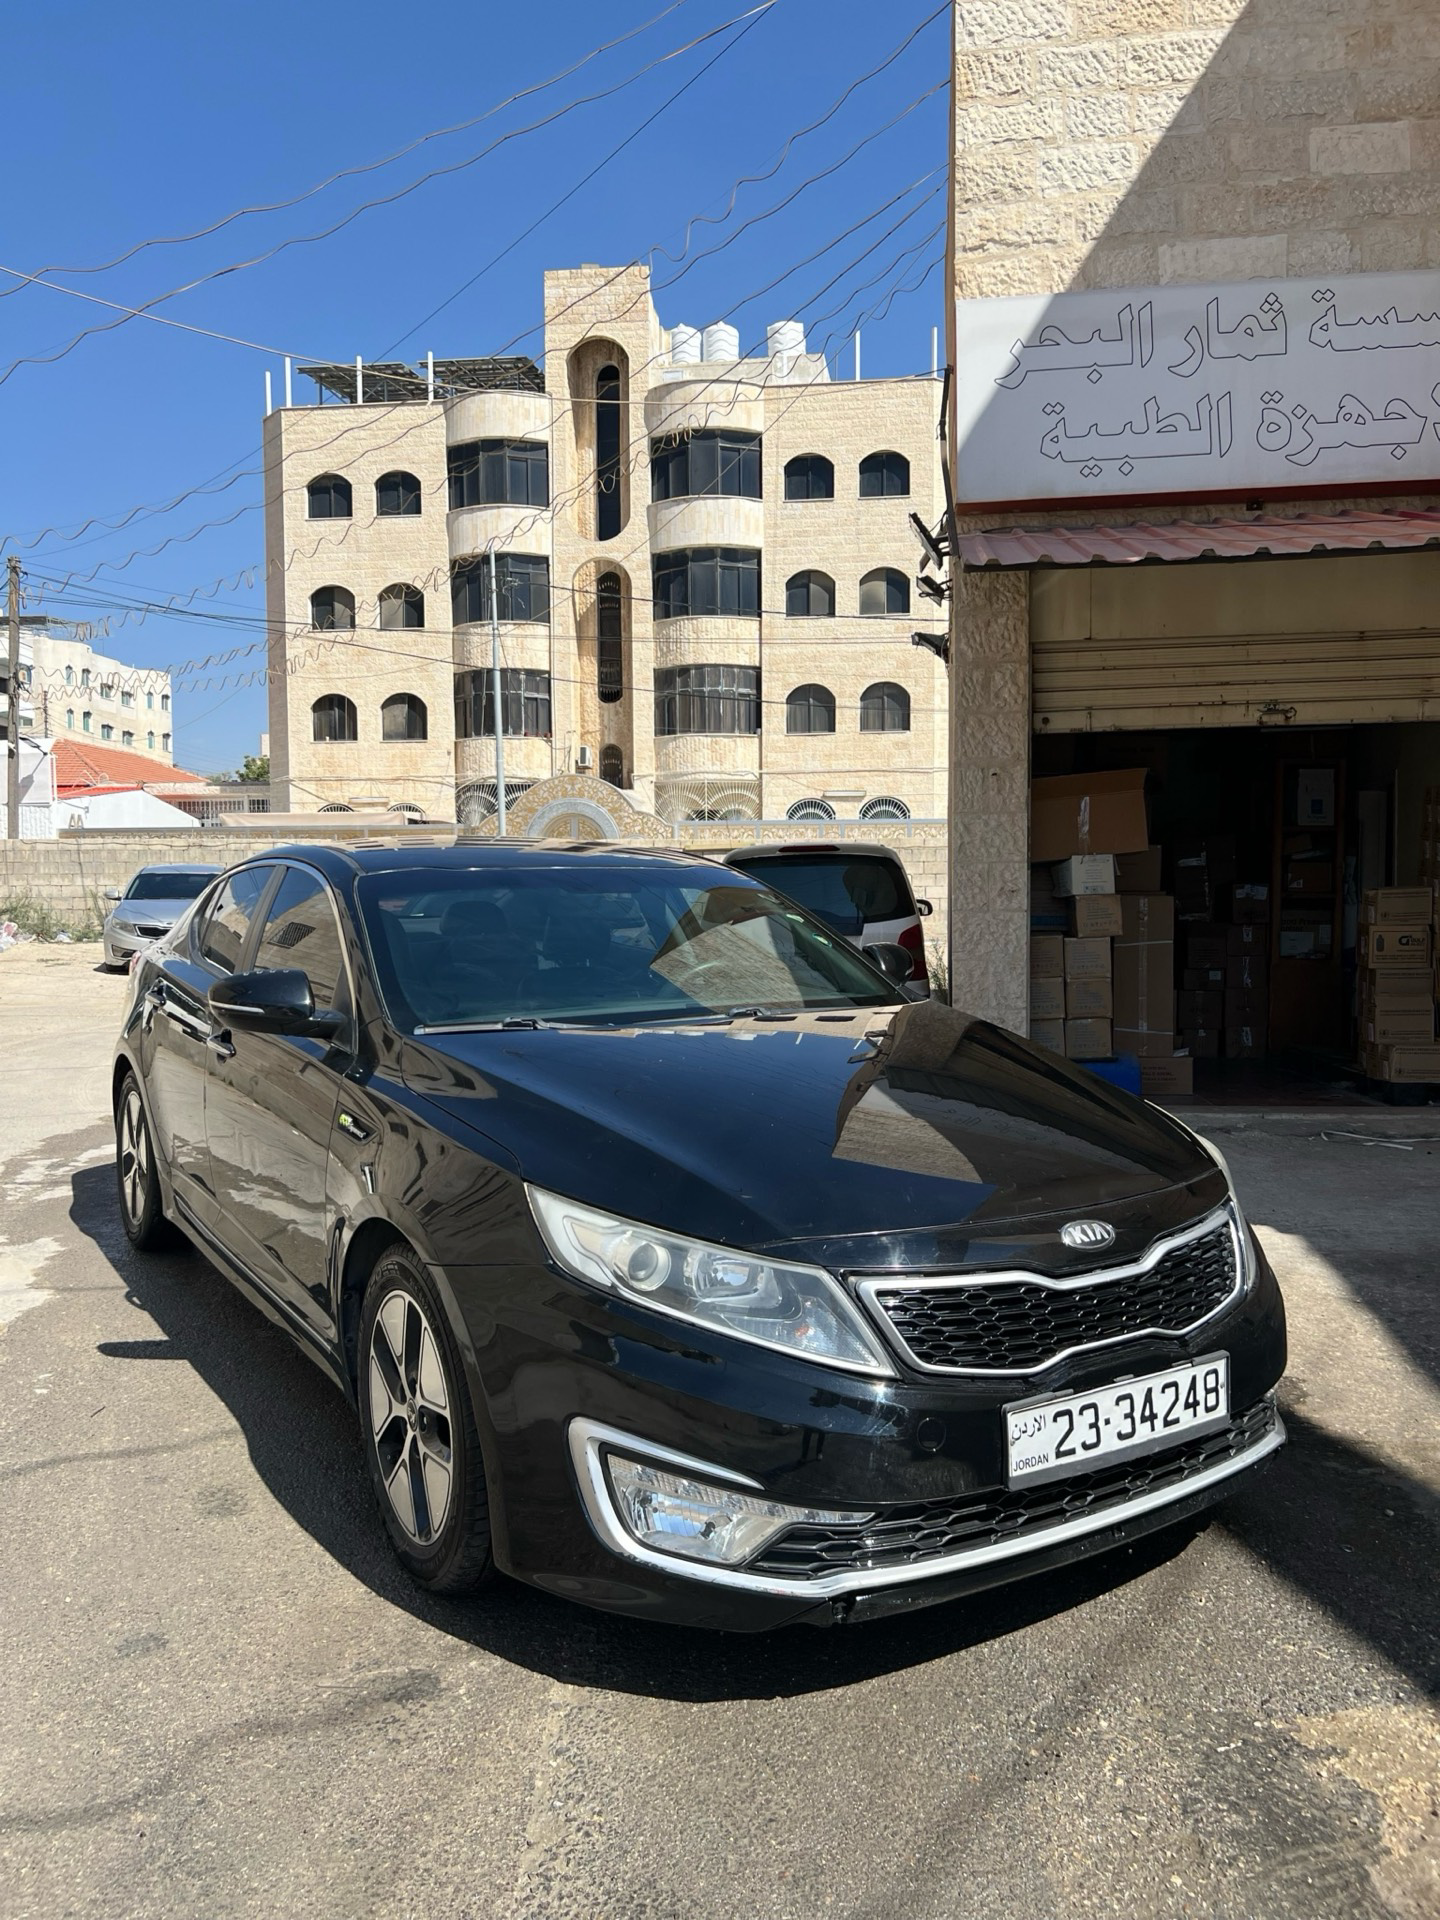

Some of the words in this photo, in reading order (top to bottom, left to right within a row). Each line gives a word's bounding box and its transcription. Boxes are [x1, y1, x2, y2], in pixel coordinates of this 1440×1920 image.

[993, 300, 1153, 390] البحر
[1167, 292, 1288, 378] ثمار
[1039, 391, 1233, 478] الطبية
[1067, 1223, 1110, 1244] KIA
[1013, 1452, 1049, 1472] JORDAN
